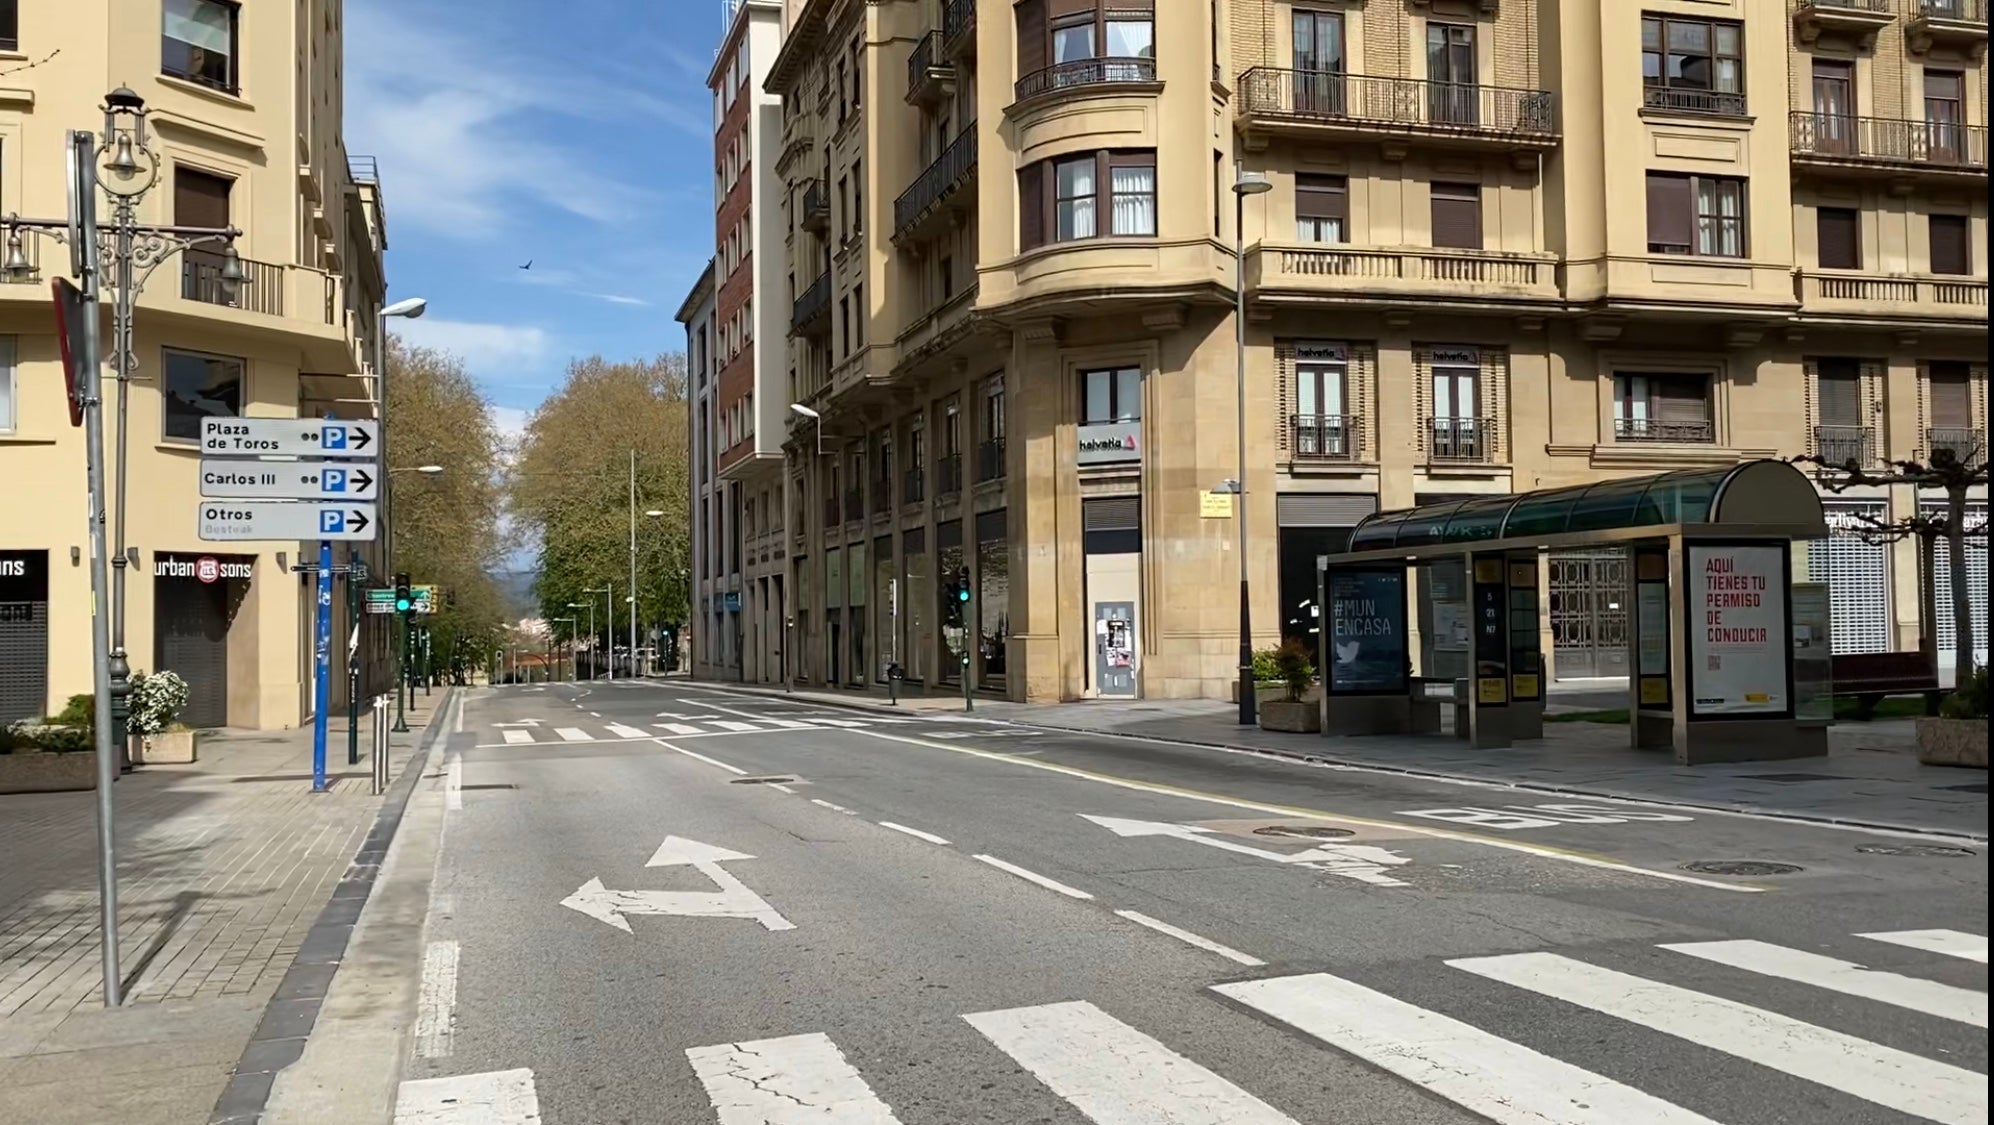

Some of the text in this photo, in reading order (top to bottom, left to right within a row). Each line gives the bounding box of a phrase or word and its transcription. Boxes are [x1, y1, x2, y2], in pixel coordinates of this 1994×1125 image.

[1297, 349, 1335, 358] helvetia
[1432, 350, 1469, 361] helvetia
[207, 423, 249, 435] Plaza
[207, 437, 279, 450] de Toros
[325, 428, 343, 448] P
[1079, 436, 1122, 451] helvetia
[204, 472, 276, 485] Carlos III
[325, 471, 343, 490] P
[206, 508, 253, 520] Otros
[323, 511, 341, 531] P
[0, 560, 25, 576] ns
[154, 554, 195, 577] urban
[220, 563, 252, 578] sons
[1706, 556, 1735, 573] AQUÍ
[1706, 575, 1766, 590] TIENES TU
[1707, 593, 1760, 607] PERMISO
[1334, 599, 1376, 617] #MUN
[1707, 611, 1722, 625] DE
[1335, 618, 1392, 636] ENCASA
[1707, 628, 1767, 643] CONDUCIR
[1392, 804, 1695, 830] BUS
